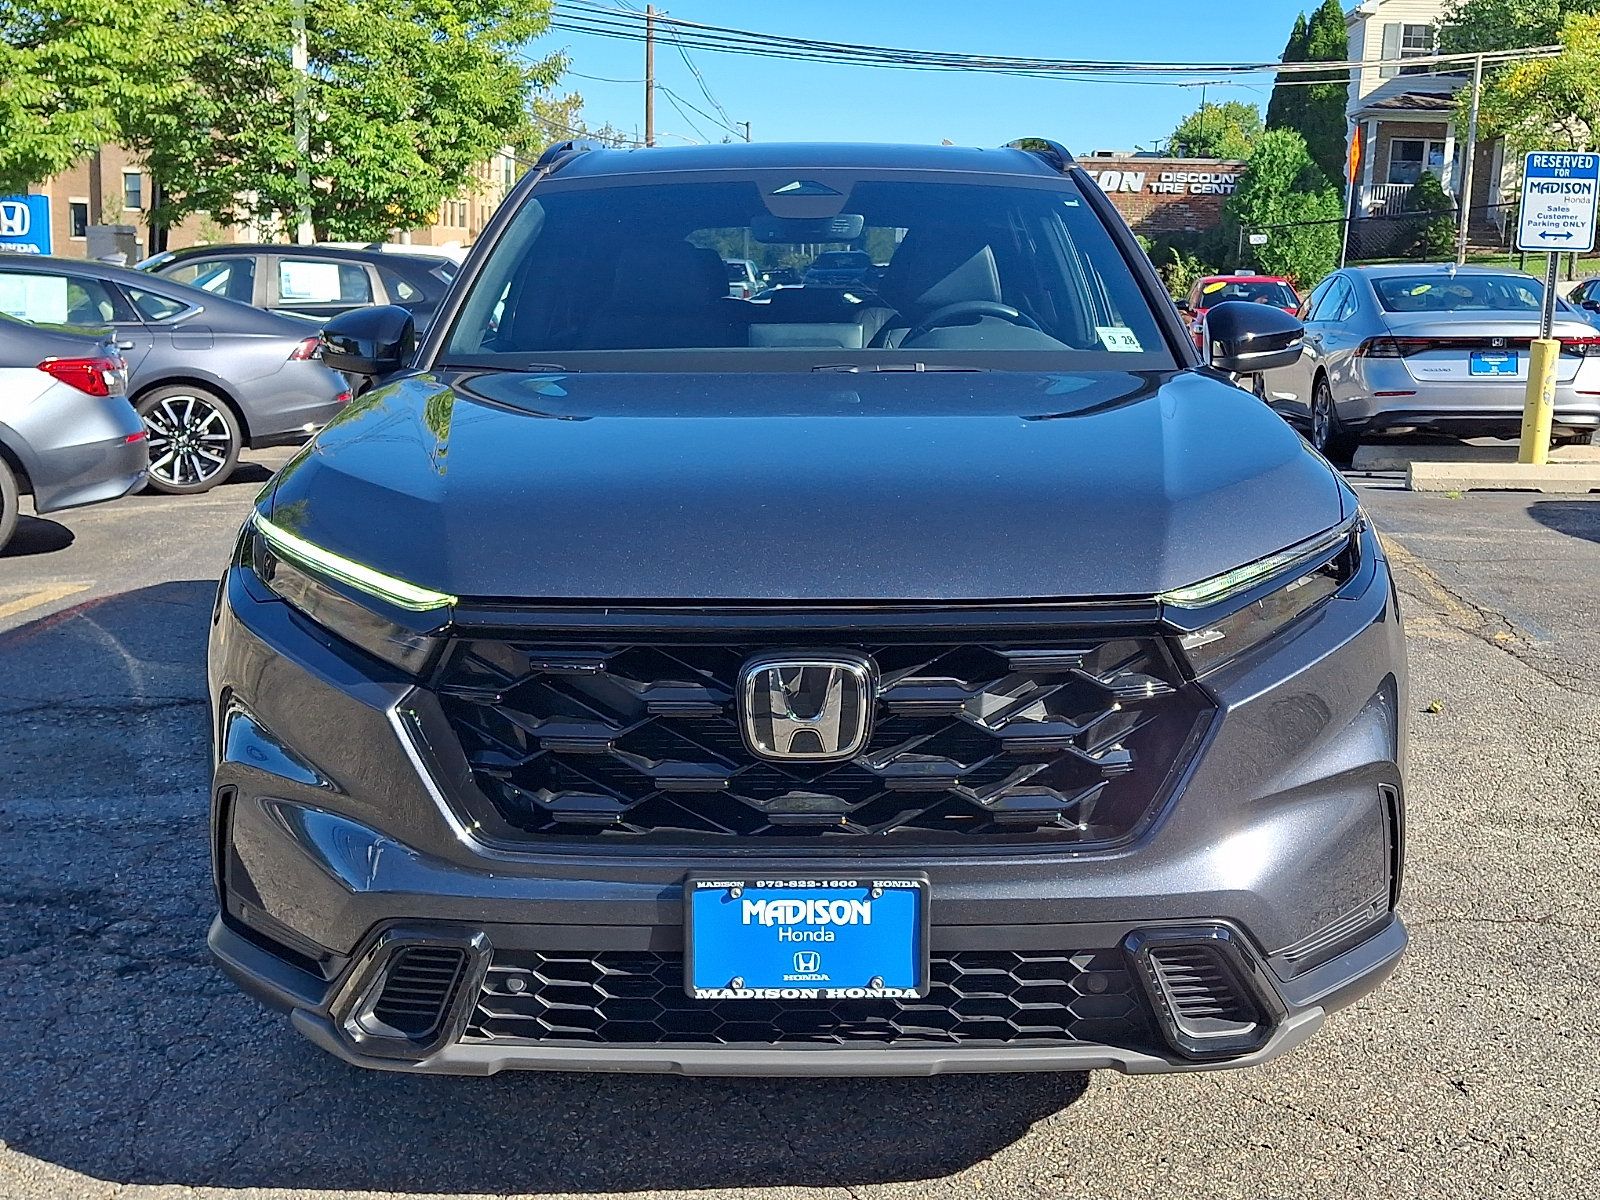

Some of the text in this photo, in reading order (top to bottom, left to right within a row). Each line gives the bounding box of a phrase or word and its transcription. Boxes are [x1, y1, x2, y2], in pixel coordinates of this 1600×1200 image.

[1533, 155, 1593, 168] RESERVED
[1554, 168, 1571, 177] FOR
[1149, 182, 1238, 194] TIRE CENT
[1530, 182, 1591, 194] MADISON
[1563, 196, 1591, 204] Honda
[1536, 212, 1579, 220] Customer
[1527, 220, 1560, 229] Parking
[1108, 335, 1136, 345] 9 28
[696, 880, 921, 889] MADISON 973-822-1600 HONDA
[741, 899, 872, 927] MADISON
[777, 926, 836, 942] Honda
[782, 974, 831, 982] HONDA
[694, 988, 921, 1000] MADISON HONDA
